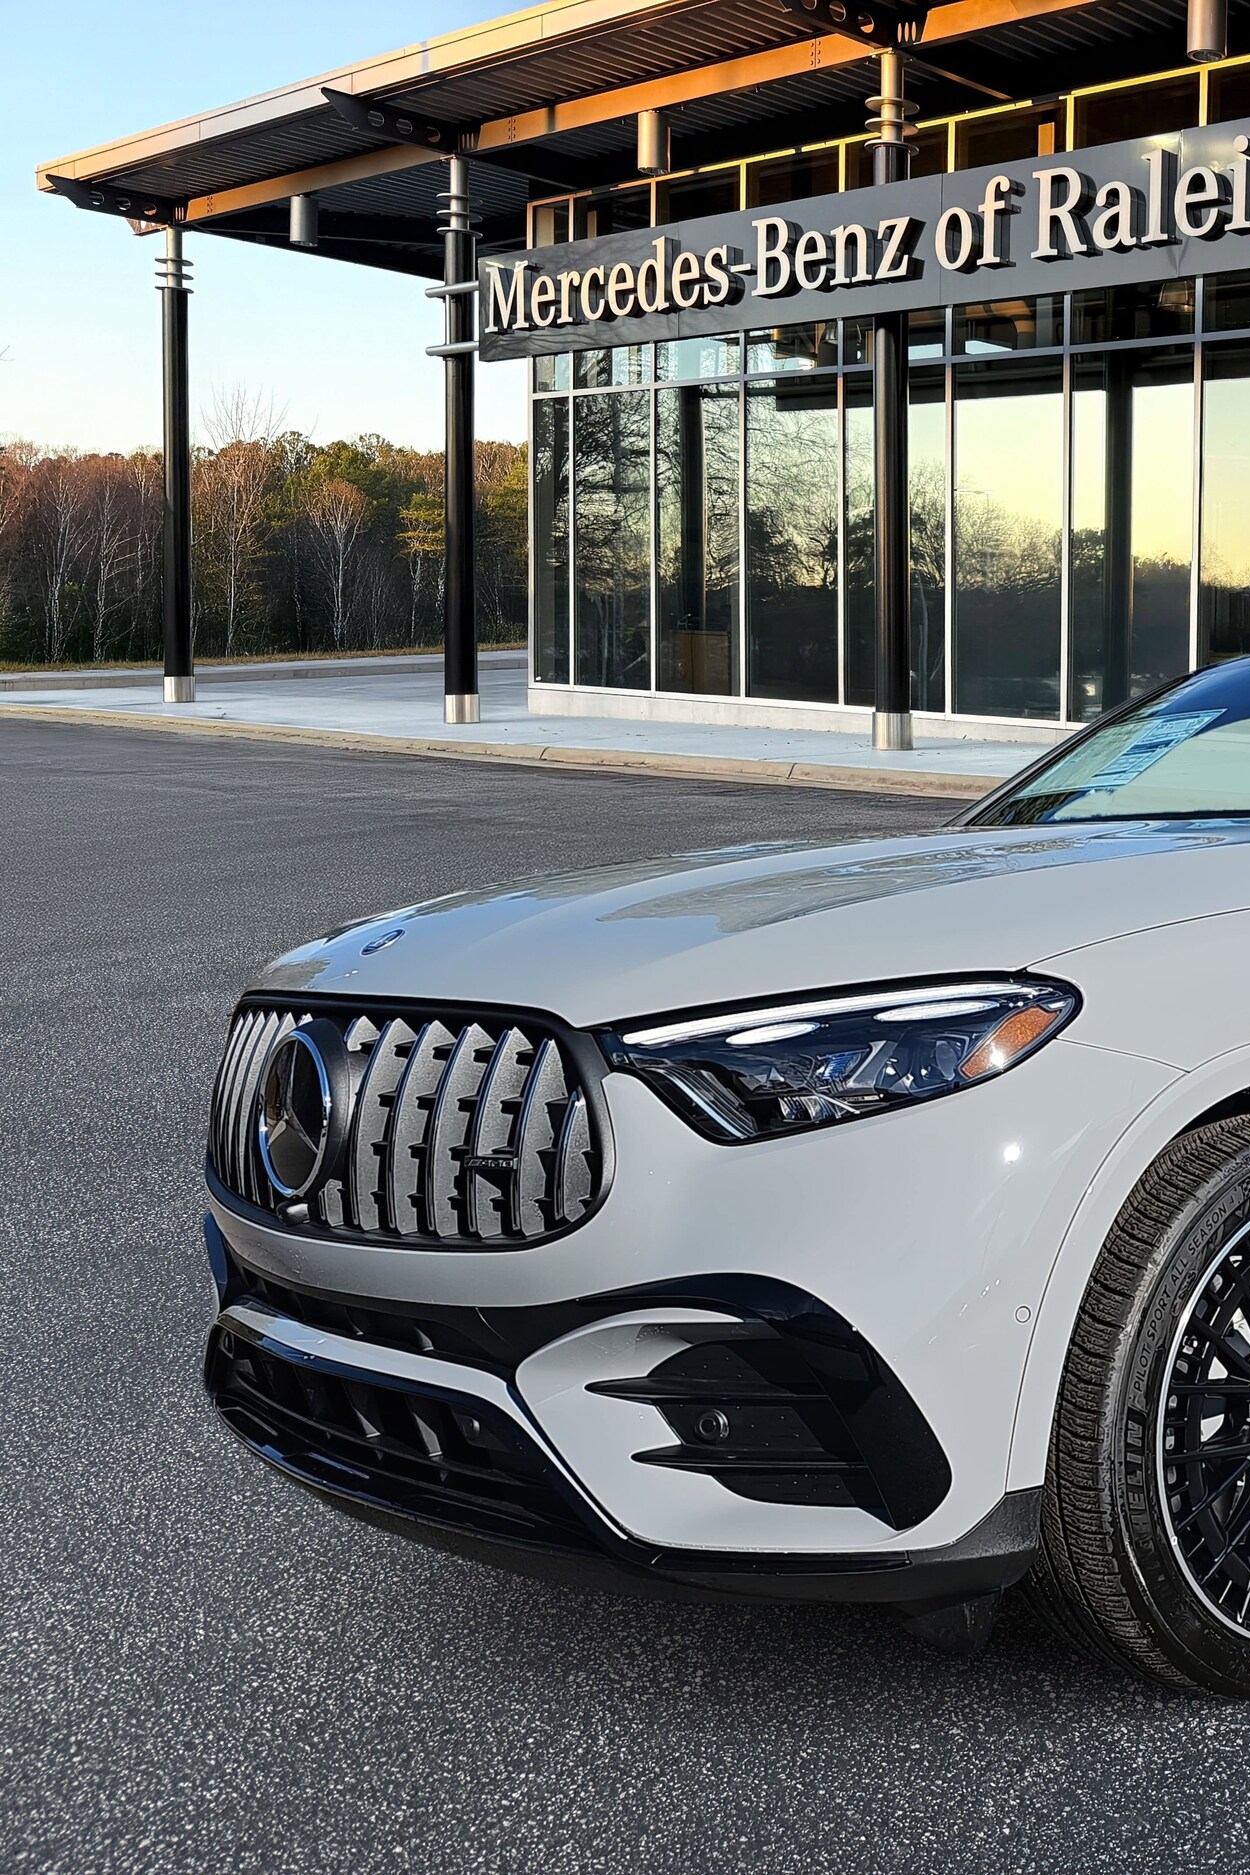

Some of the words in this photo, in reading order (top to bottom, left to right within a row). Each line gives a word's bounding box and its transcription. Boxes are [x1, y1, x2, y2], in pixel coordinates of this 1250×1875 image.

[484, 216, 911, 334] Mercedes-Benz
[934, 175, 1011, 271] of
[1133, 1343, 1149, 1392] PILOT
[1146, 1286, 1175, 1344] SPORT
[1170, 1258, 1188, 1287] ALL
[1187, 1206, 1228, 1256] SEASON
